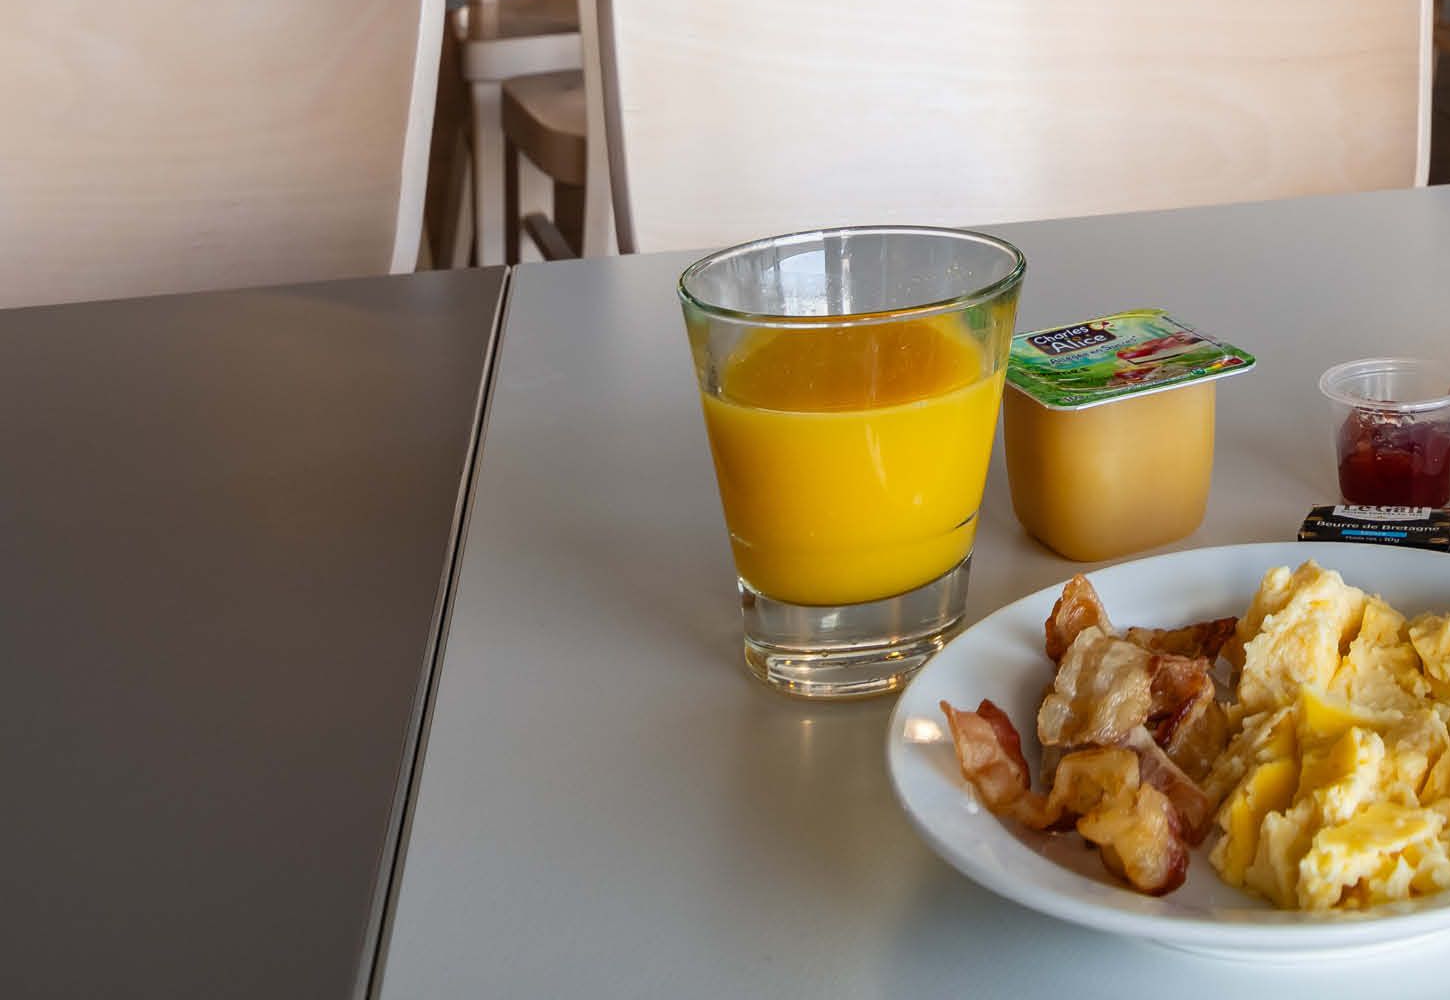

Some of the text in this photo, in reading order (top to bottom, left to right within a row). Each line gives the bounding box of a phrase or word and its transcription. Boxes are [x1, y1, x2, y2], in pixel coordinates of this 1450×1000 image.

[1034, 326, 1089, 345] Charles
[1051, 334, 1106, 353] Alice
[1316, 520, 1358, 528] Beurre
